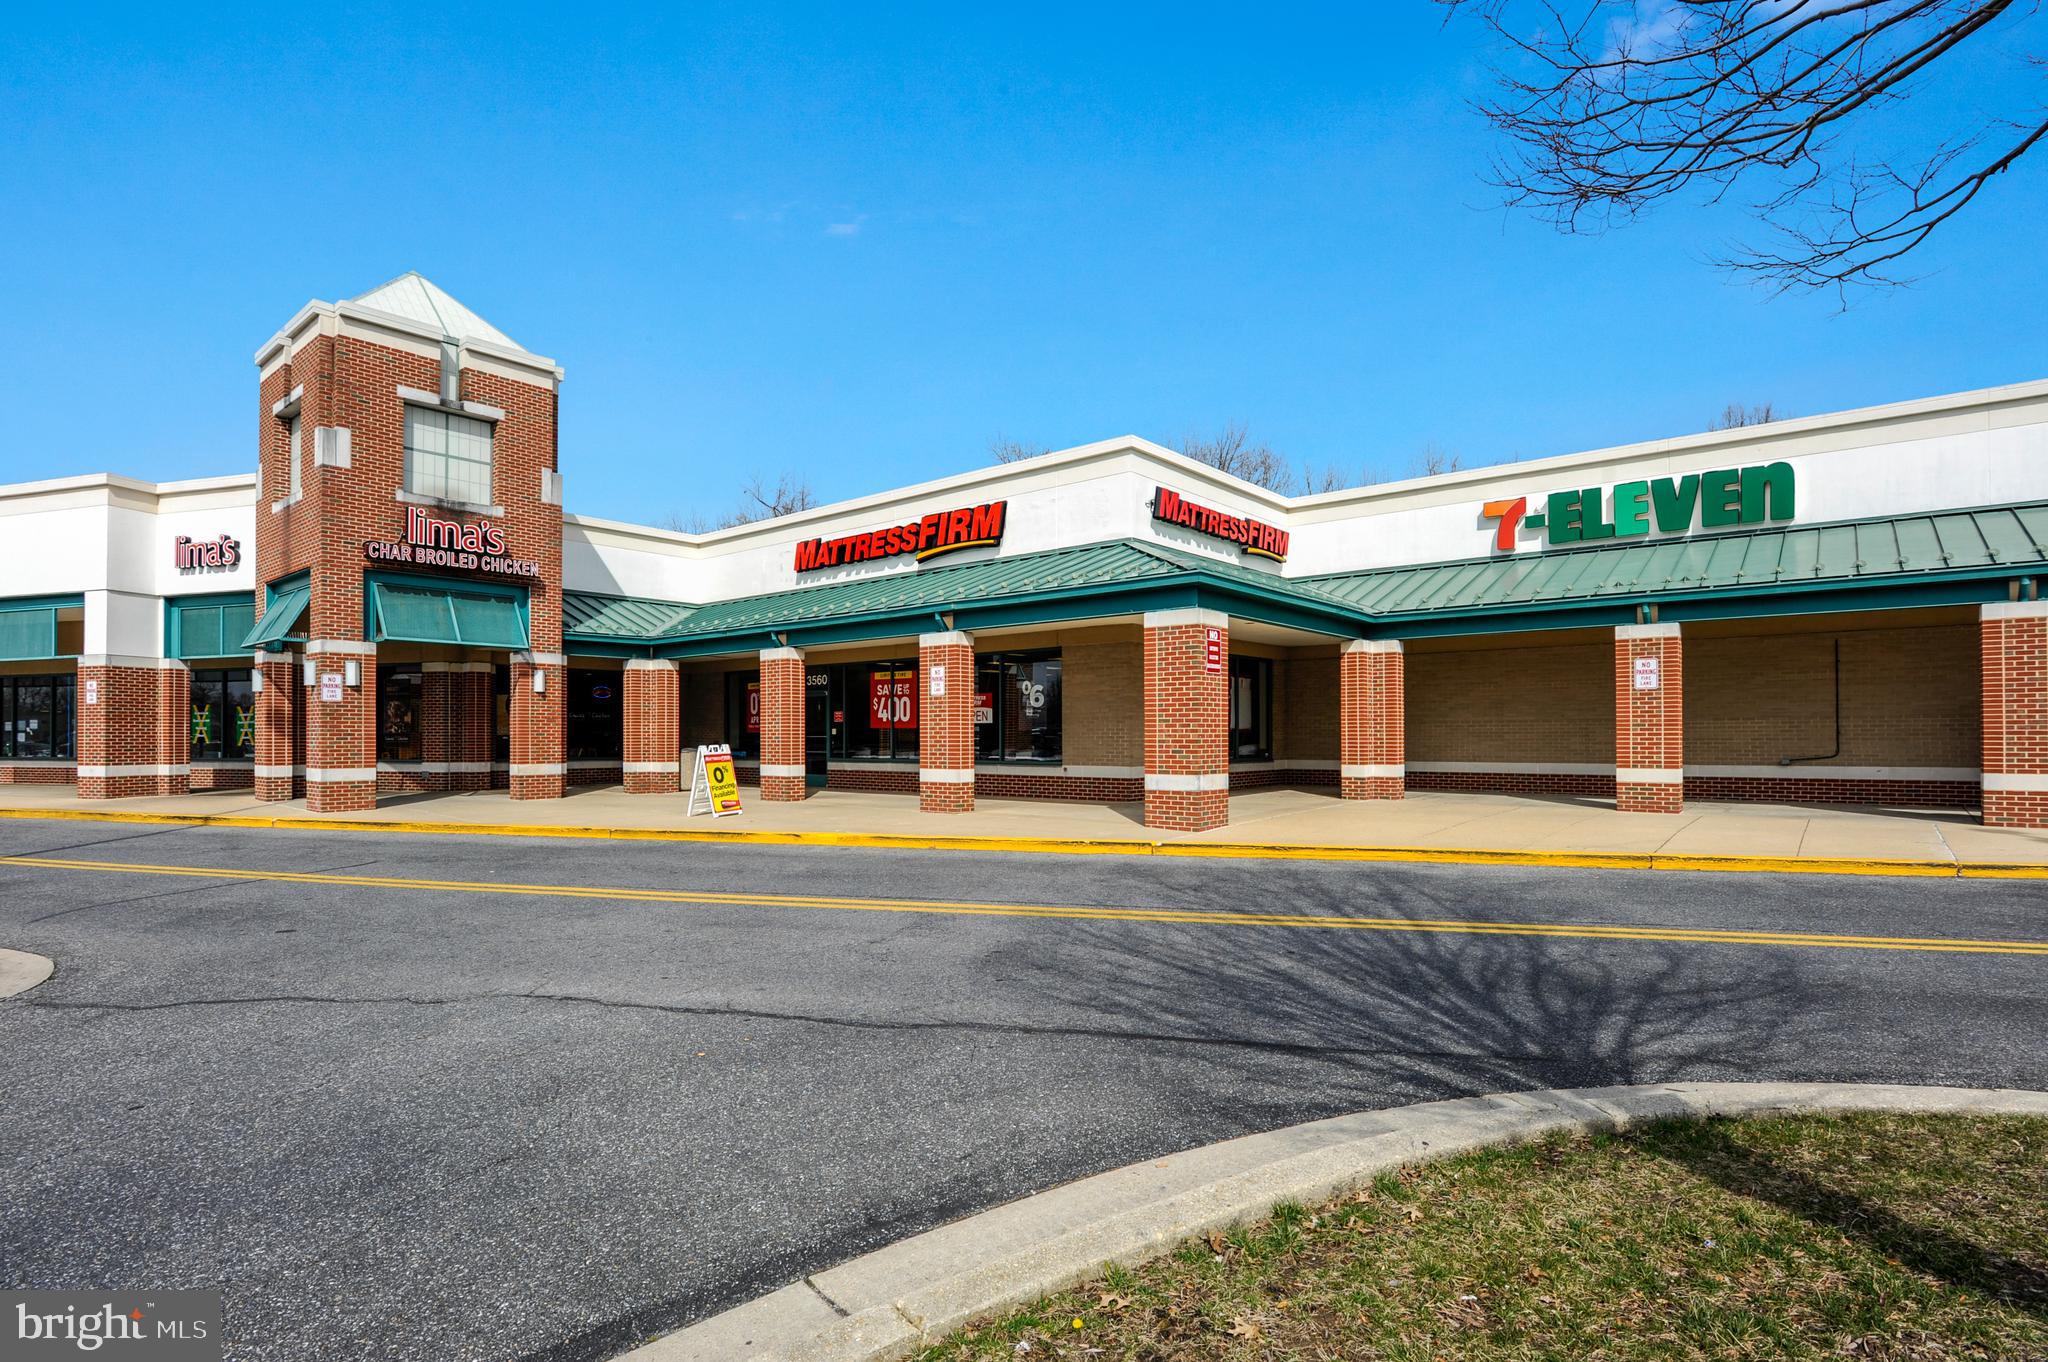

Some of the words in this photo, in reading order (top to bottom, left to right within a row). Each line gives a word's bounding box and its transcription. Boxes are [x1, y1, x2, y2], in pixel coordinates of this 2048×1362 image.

[407, 506, 505, 555] lima's
[175, 534, 239, 568] lima's
[368, 541, 412, 562] CHAR
[415, 547, 478, 570] BROILED
[481, 555, 539, 577] CHICKEN
[1209, 630, 1219, 640] NO
[806, 674, 828, 686] 3560
[873, 696, 911, 722] $400
